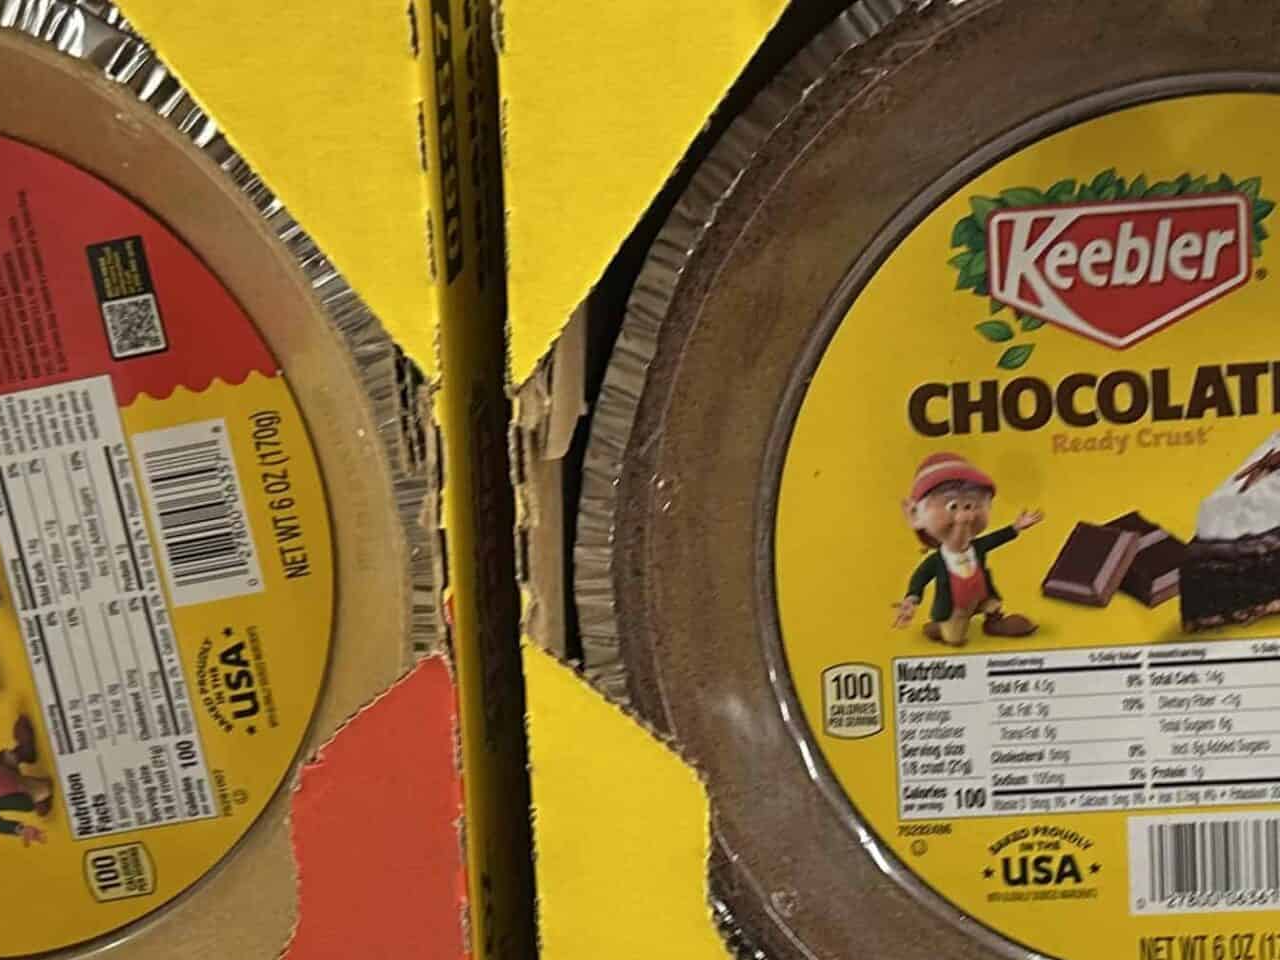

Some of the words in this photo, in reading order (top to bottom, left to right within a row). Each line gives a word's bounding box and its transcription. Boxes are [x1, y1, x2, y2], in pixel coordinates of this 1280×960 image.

[1004, 212, 1236, 320] Keebler
[907, 361, 1280, 438] CHOCOLAT
[249, 409, 287, 466] (170g)
[1051, 430, 1128, 456] Ready
[1136, 426, 1207, 448] Crust
[263, 469, 289, 494] OZ
[270, 496, 293, 511] 6
[273, 512, 300, 542] WT
[280, 542, 309, 580] NET
[195, 637, 214, 693] PROUDLY
[208, 666, 220, 690] THE
[221, 641, 261, 720] USA
[897, 661, 967, 682] Nutrition
[831, 673, 874, 700] 100
[898, 684, 942, 704] Facts
[176, 738, 197, 768] 100
[138, 765, 151, 784] size
[66, 773, 92, 835] Nutrition
[144, 786, 163, 822] Serving
[182, 776, 198, 815] Calories
[955, 787, 986, 809] 100
[91, 794, 111, 832] Facts
[1032, 825, 1094, 851] PROUDLY
[92, 855, 122, 894] 100
[1002, 854, 1083, 886] USA
